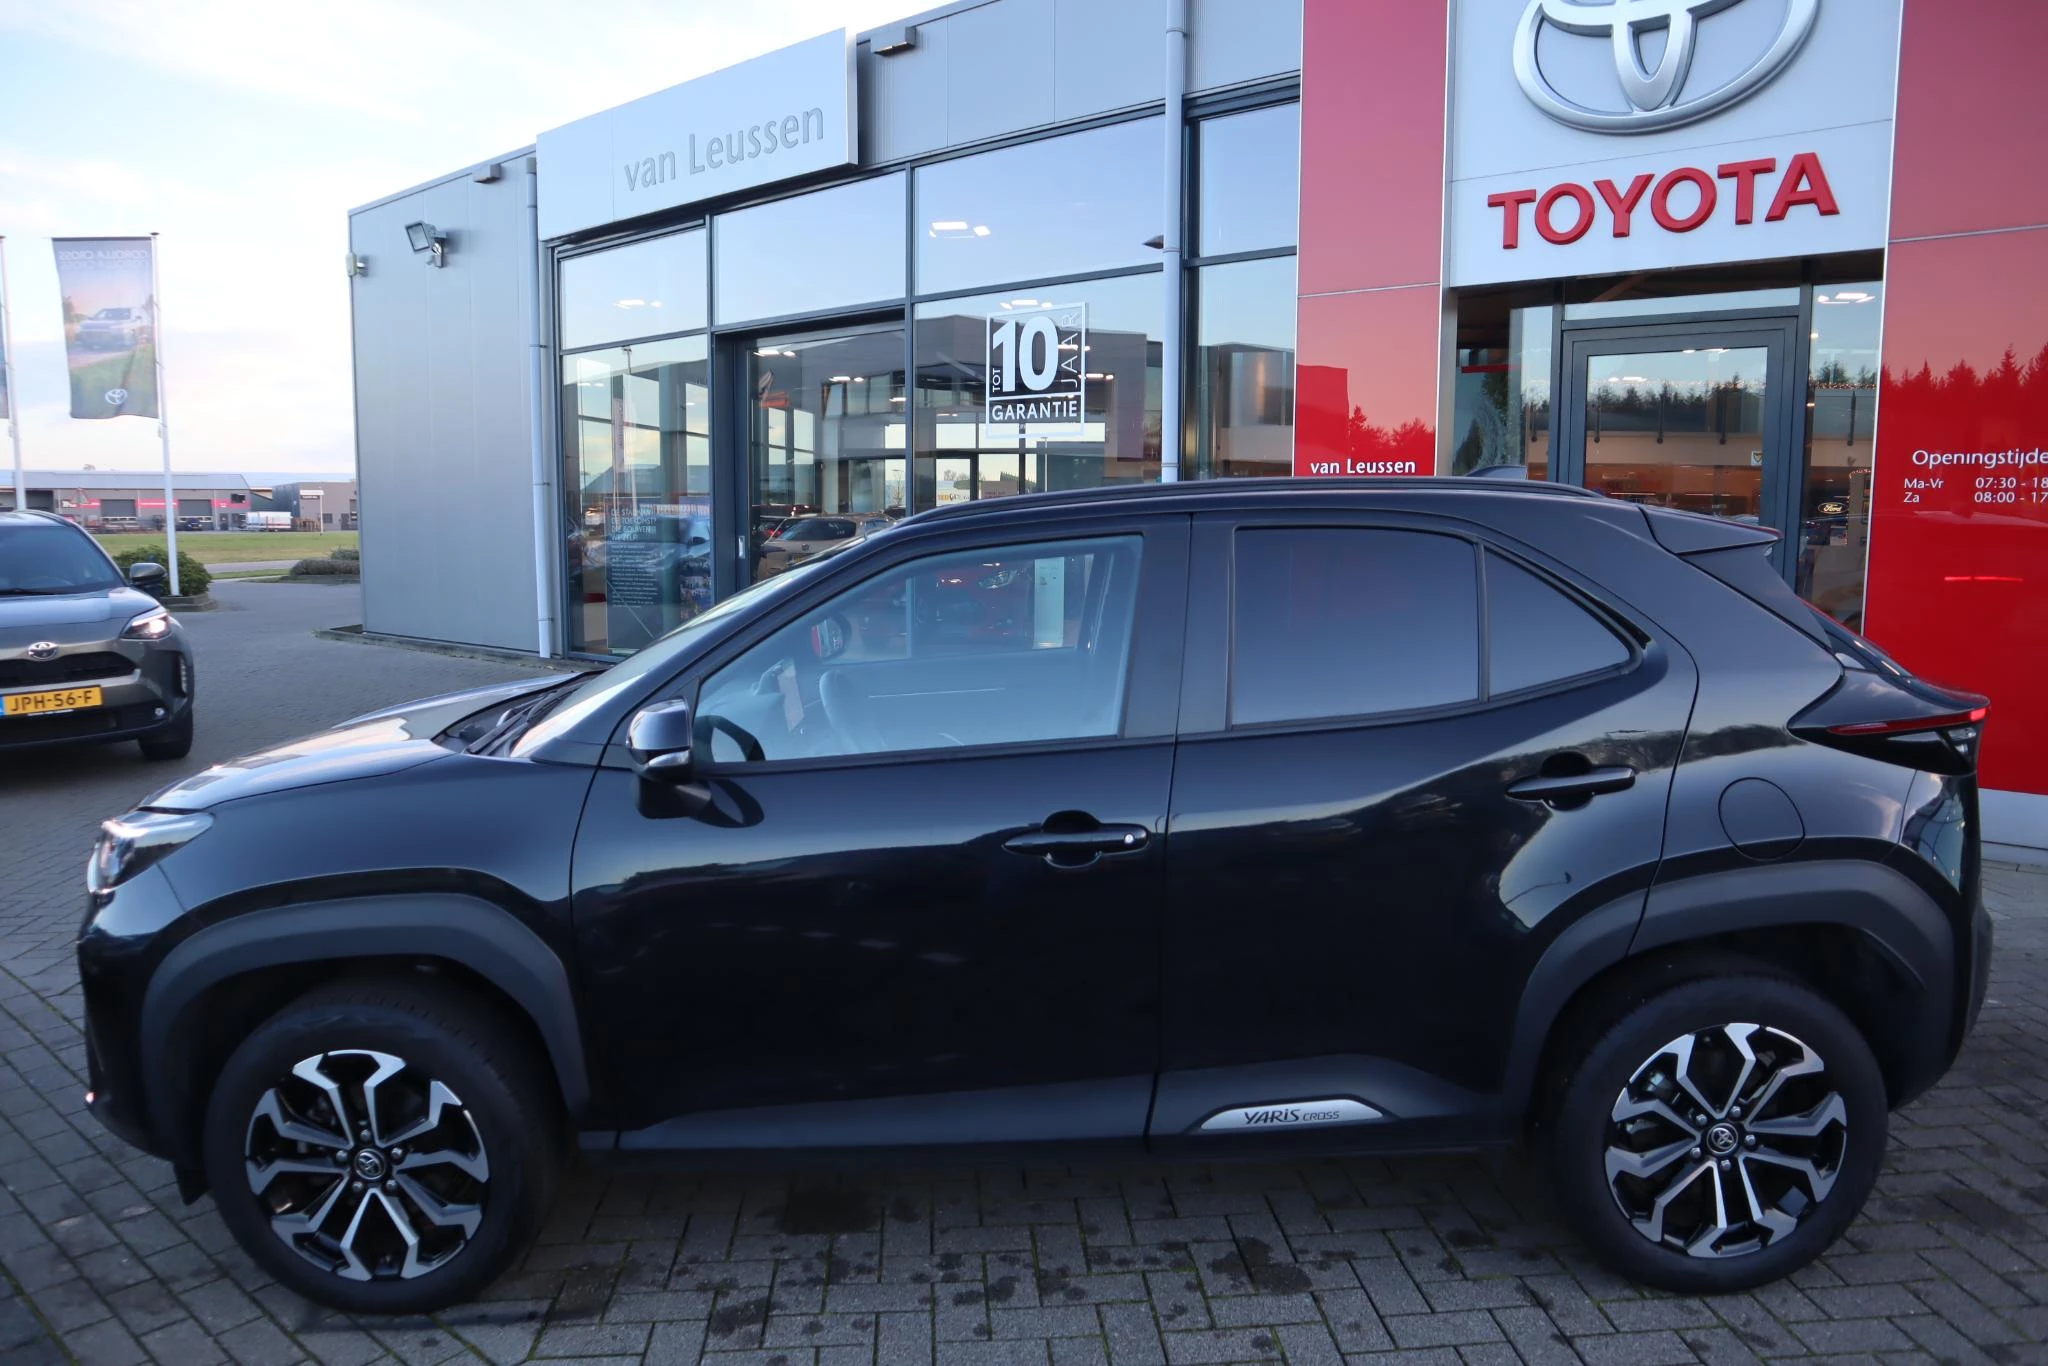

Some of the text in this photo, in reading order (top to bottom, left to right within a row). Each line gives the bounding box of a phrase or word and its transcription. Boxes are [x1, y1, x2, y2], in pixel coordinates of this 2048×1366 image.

[624, 107, 824, 192] van Leussen
[1488, 152, 1840, 249] TOYOTA
[992, 311, 1081, 393] TOT 10 JAAR
[991, 400, 1078, 420] GARANTIE
[1310, 458, 1416, 474] van Leussen
[1912, 447, 2048, 470] Openingstijde
[1904, 478, 1944, 489] Ma-Vr
[1975, 477, 2017, 489] 07:30
[1903, 491, 1920, 503] Za
[1974, 491, 2015, 503] 08:00
[11, 690, 92, 711] JPH-56-F
[1302, 1110, 1340, 1122] CROSS
